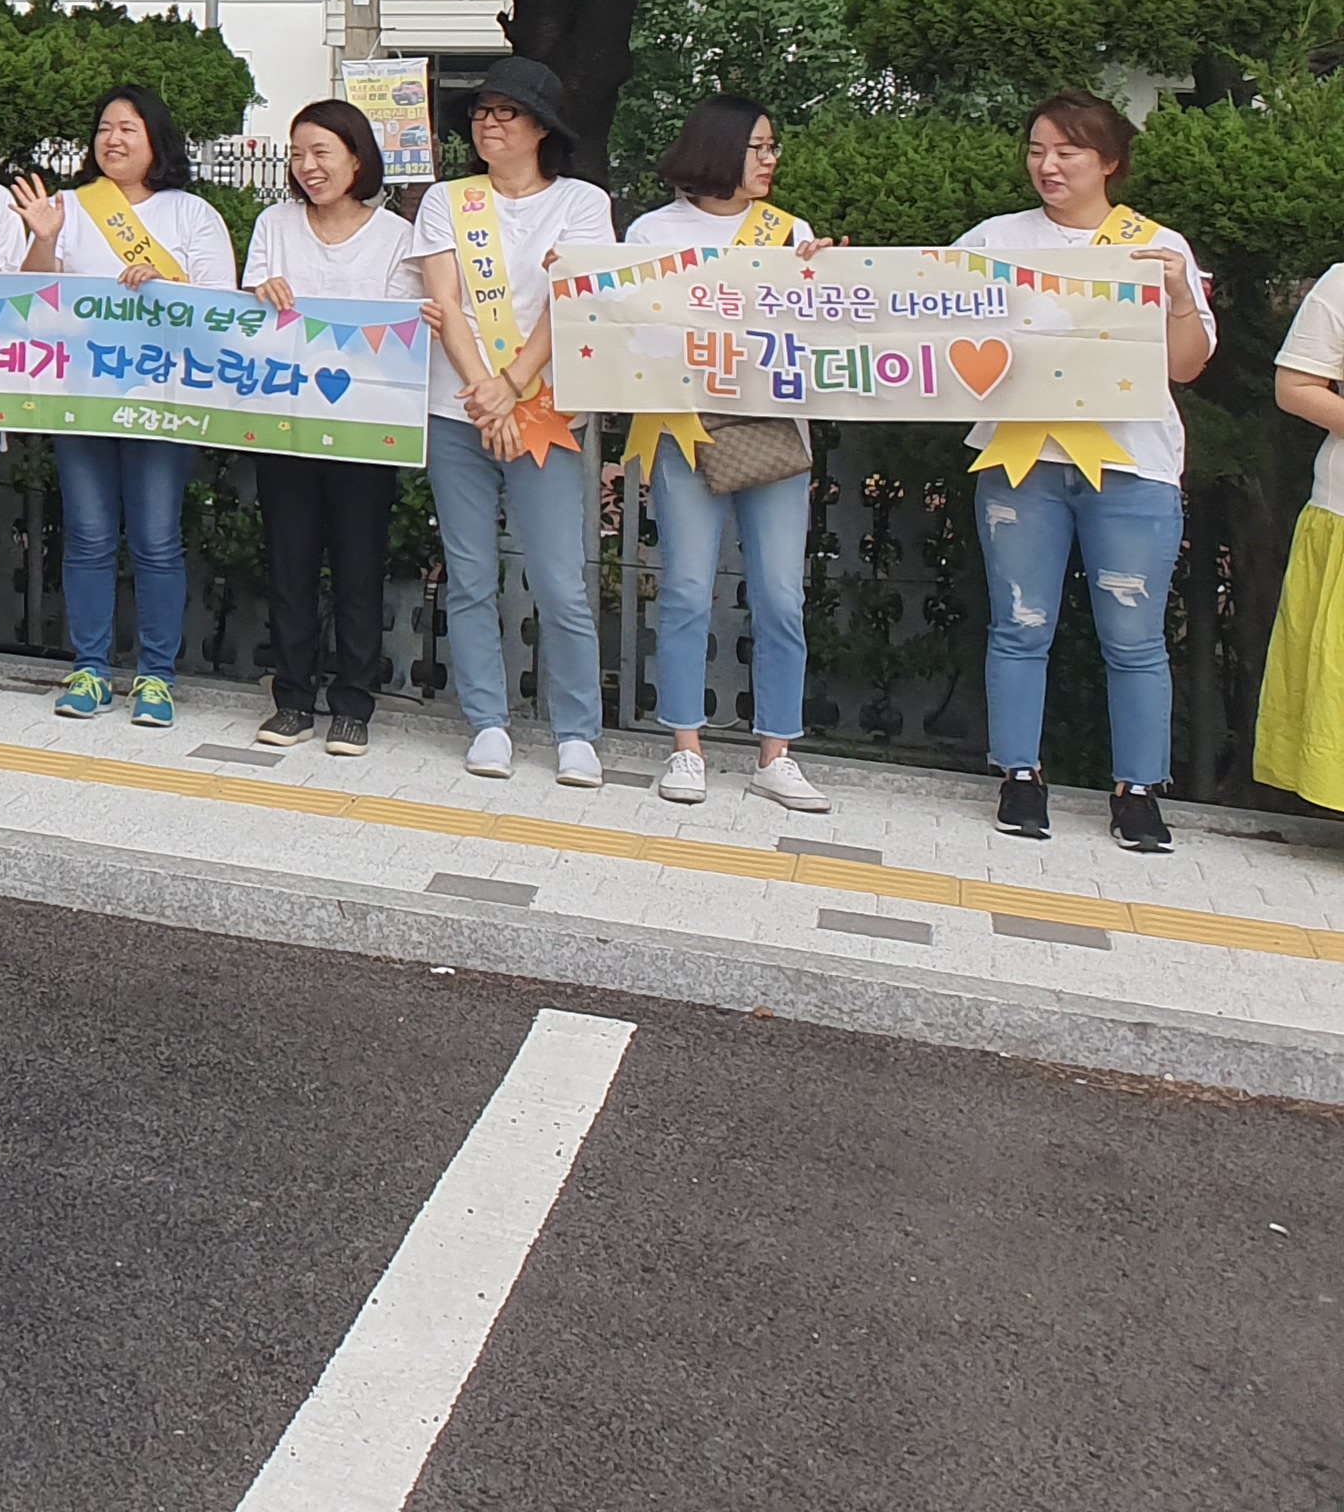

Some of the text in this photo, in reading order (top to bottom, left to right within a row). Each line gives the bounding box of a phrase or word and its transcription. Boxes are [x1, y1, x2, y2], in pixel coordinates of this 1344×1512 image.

[73, 294, 267, 337] 이세상의 보물
[688, 282, 1007, 319] 오늘 주인공은 나야나!!
[86, 339, 309, 397] 자랑스럽다
[685, 329, 935, 400] 반갑데이
